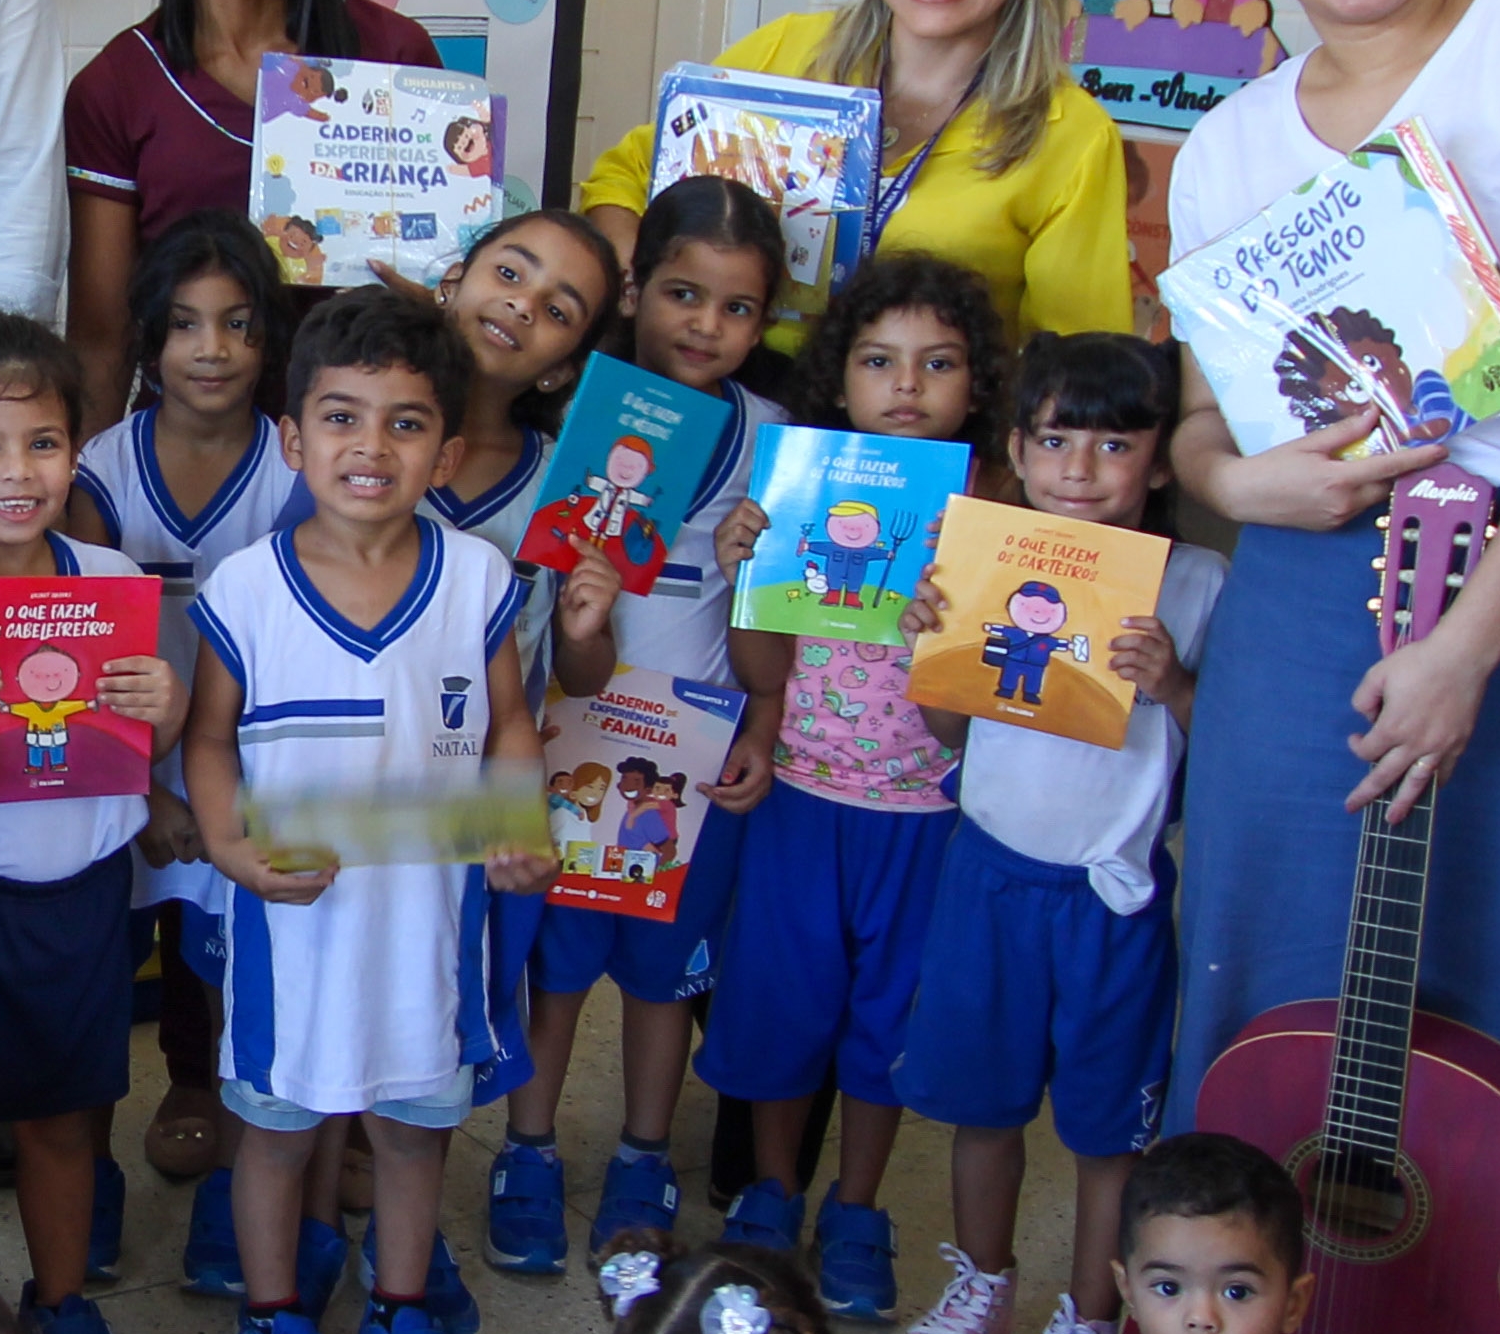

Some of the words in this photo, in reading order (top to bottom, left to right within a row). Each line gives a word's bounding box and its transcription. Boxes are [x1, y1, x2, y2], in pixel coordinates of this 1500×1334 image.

[319, 124, 413, 143] CADERNO
[314, 142, 439, 163] EXPERIÊNCIAS
[314, 163, 338, 178] DA
[341, 162, 448, 192] CRIANÇA
[1235, 180, 1361, 279] PRESENTE
[1281, 224, 1365, 288] TEMPO
[1005, 534, 1013, 547] O
[1018, 539, 1046, 555] QUE
[1051, 543, 1100, 564] FAZEM
[997, 550, 1012, 564] OS
[1018, 554, 1099, 582] CARTEIROS
[5, 605, 13, 619] O
[17, 605, 45, 620] QUE
[51, 602, 98, 618] FAZEM
[5, 620, 115, 641] CABELEIREIROS
[433, 741, 479, 756] NATAL
[675, 976, 715, 998] NATA
